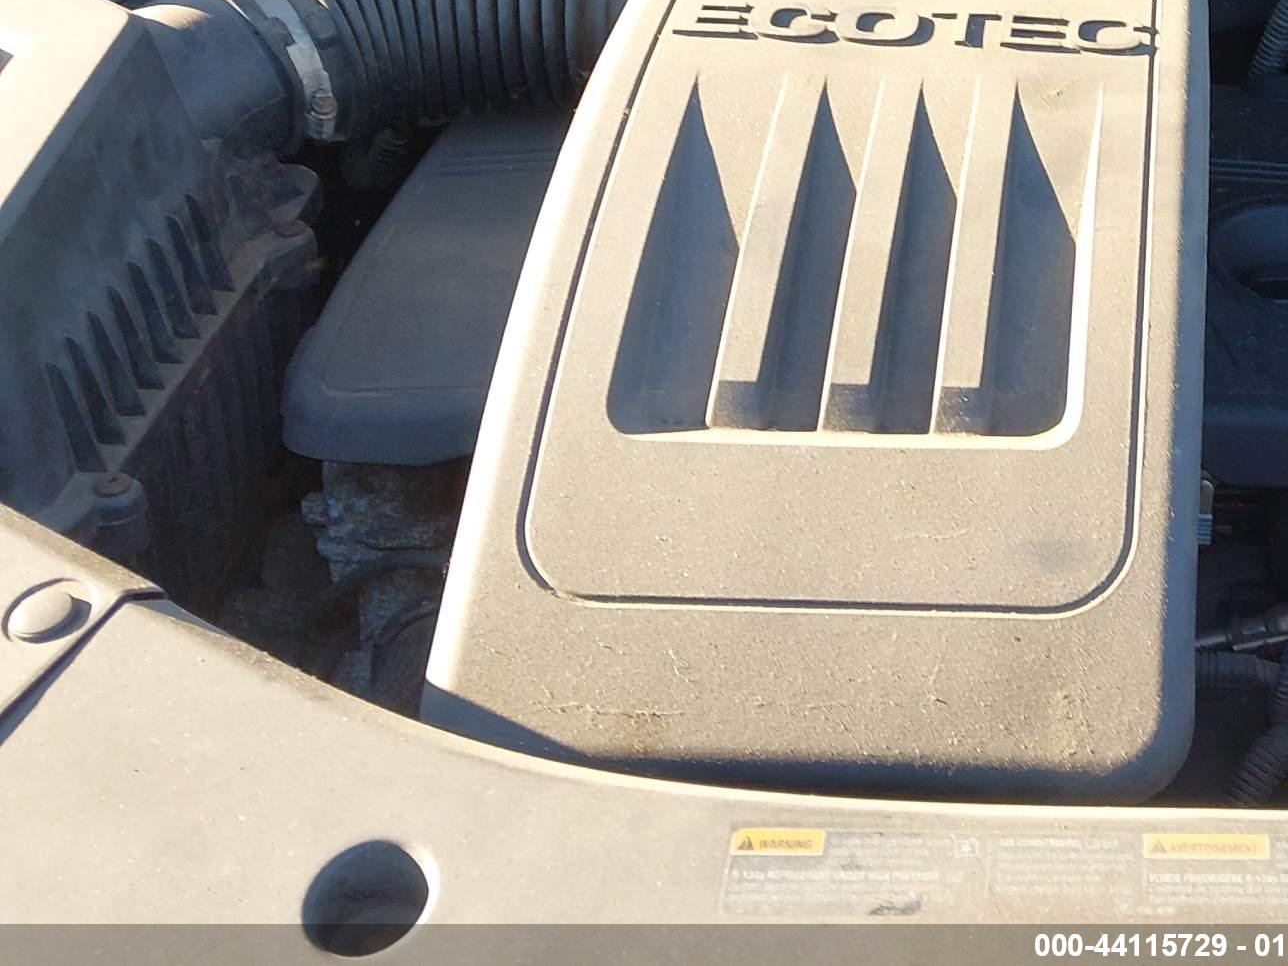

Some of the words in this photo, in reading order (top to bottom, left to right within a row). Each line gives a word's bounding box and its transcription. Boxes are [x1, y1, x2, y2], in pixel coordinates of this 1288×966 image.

[672, 4, 1159, 56] ECOTEC
[758, 839, 812, 850] WARNING
[1169, 842, 1258, 854] AVERTISSEMENT
